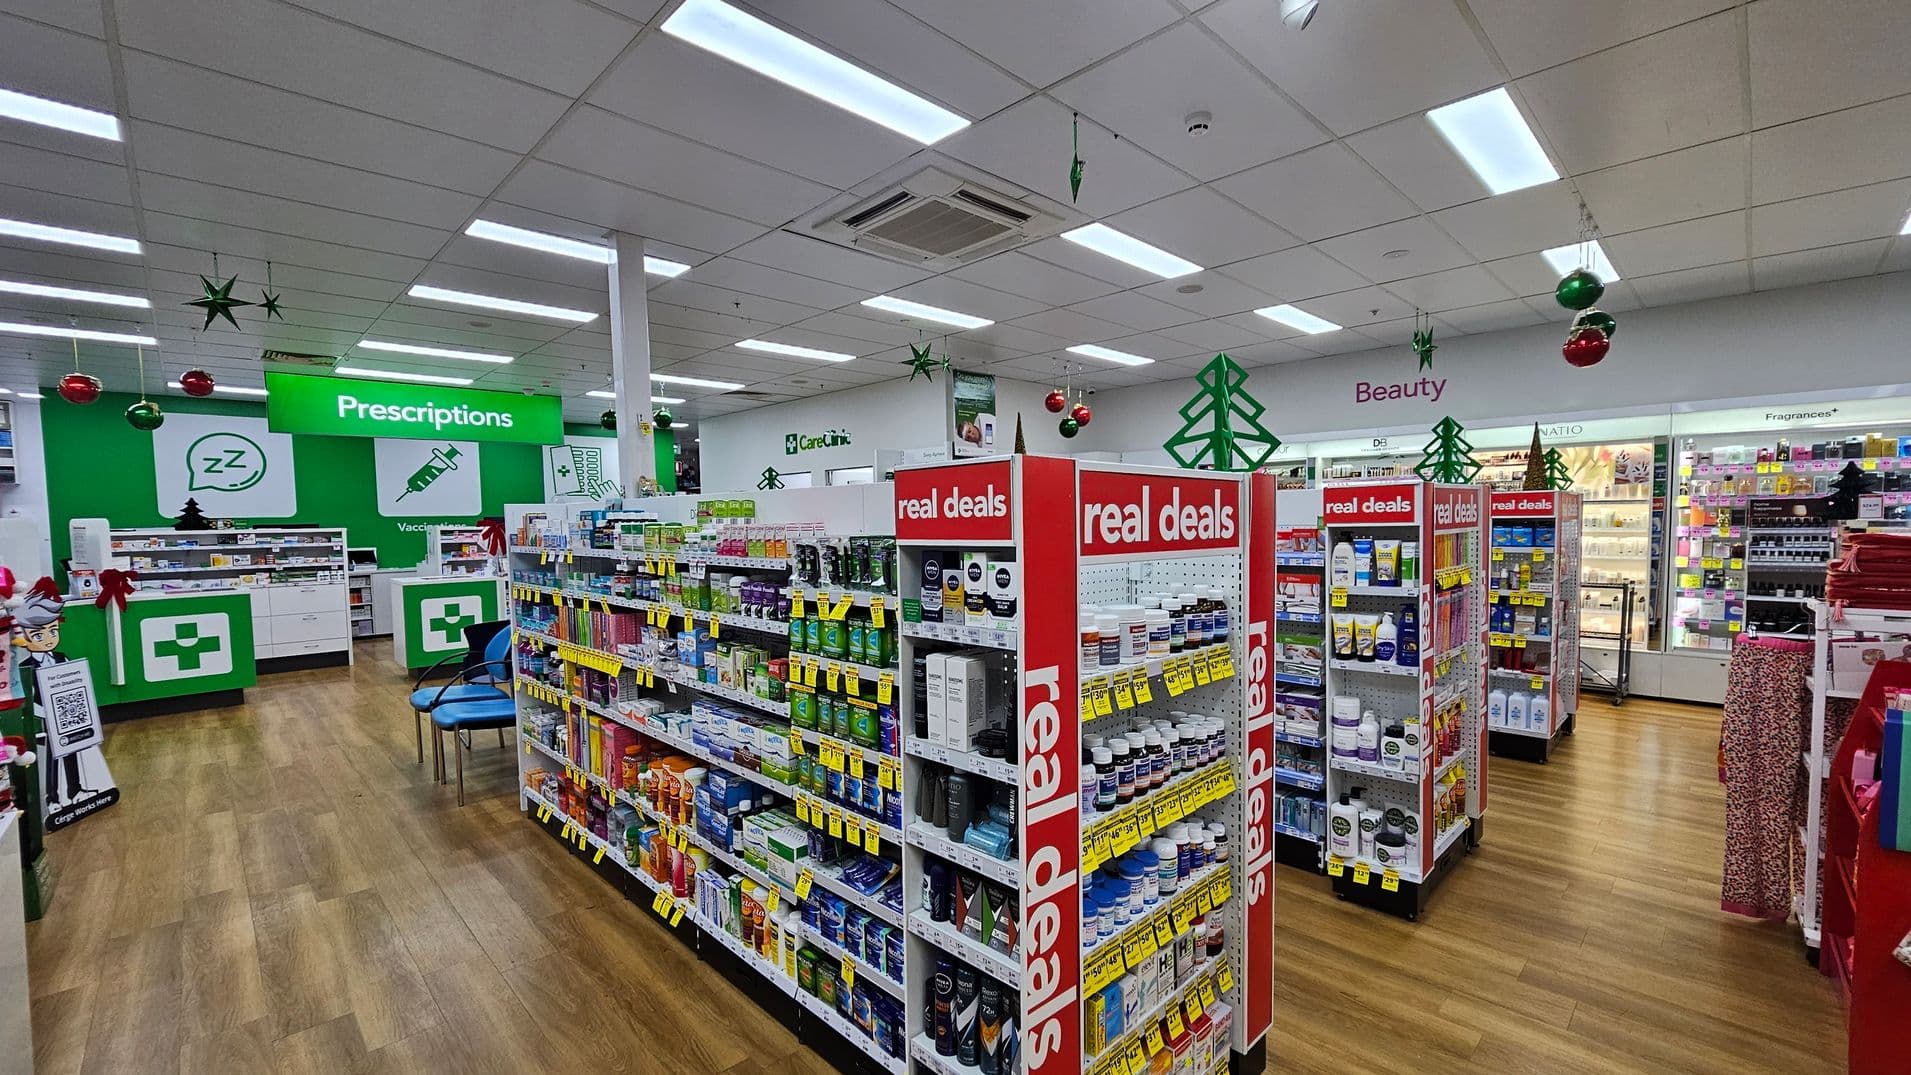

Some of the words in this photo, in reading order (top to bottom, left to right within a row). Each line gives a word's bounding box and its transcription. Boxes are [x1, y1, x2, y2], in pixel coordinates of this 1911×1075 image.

[1355, 376, 1447, 403] Beauty
[337, 395, 513, 431] Prescriptions
[1538, 425, 1583, 436] NATIO
[800, 429, 851, 450] CareClinic
[898, 487, 938, 520] real
[943, 484, 1007, 519] deals
[1083, 485, 1150, 544] real
[1158, 487, 1235, 541] deals
[1326, 497, 1358, 514] real
[1362, 496, 1411, 513] deals
[1434, 494, 1453, 523] real
[1455, 494, 1478, 523] deals
[1492, 500, 1516, 511] real
[1518, 499, 1552, 510] deals
[1422, 584, 1434, 660] real
[1248, 620, 1273, 731] real
[1422, 671, 1434, 780] deals
[1026, 665, 1077, 826] real
[74, 802, 96, 817] Works
[96, 794, 112, 807] Here
[1008, 789, 1016, 824] CREWMAN
[1247, 748, 1273, 905] deals
[1026, 845, 1077, 1070] deals
